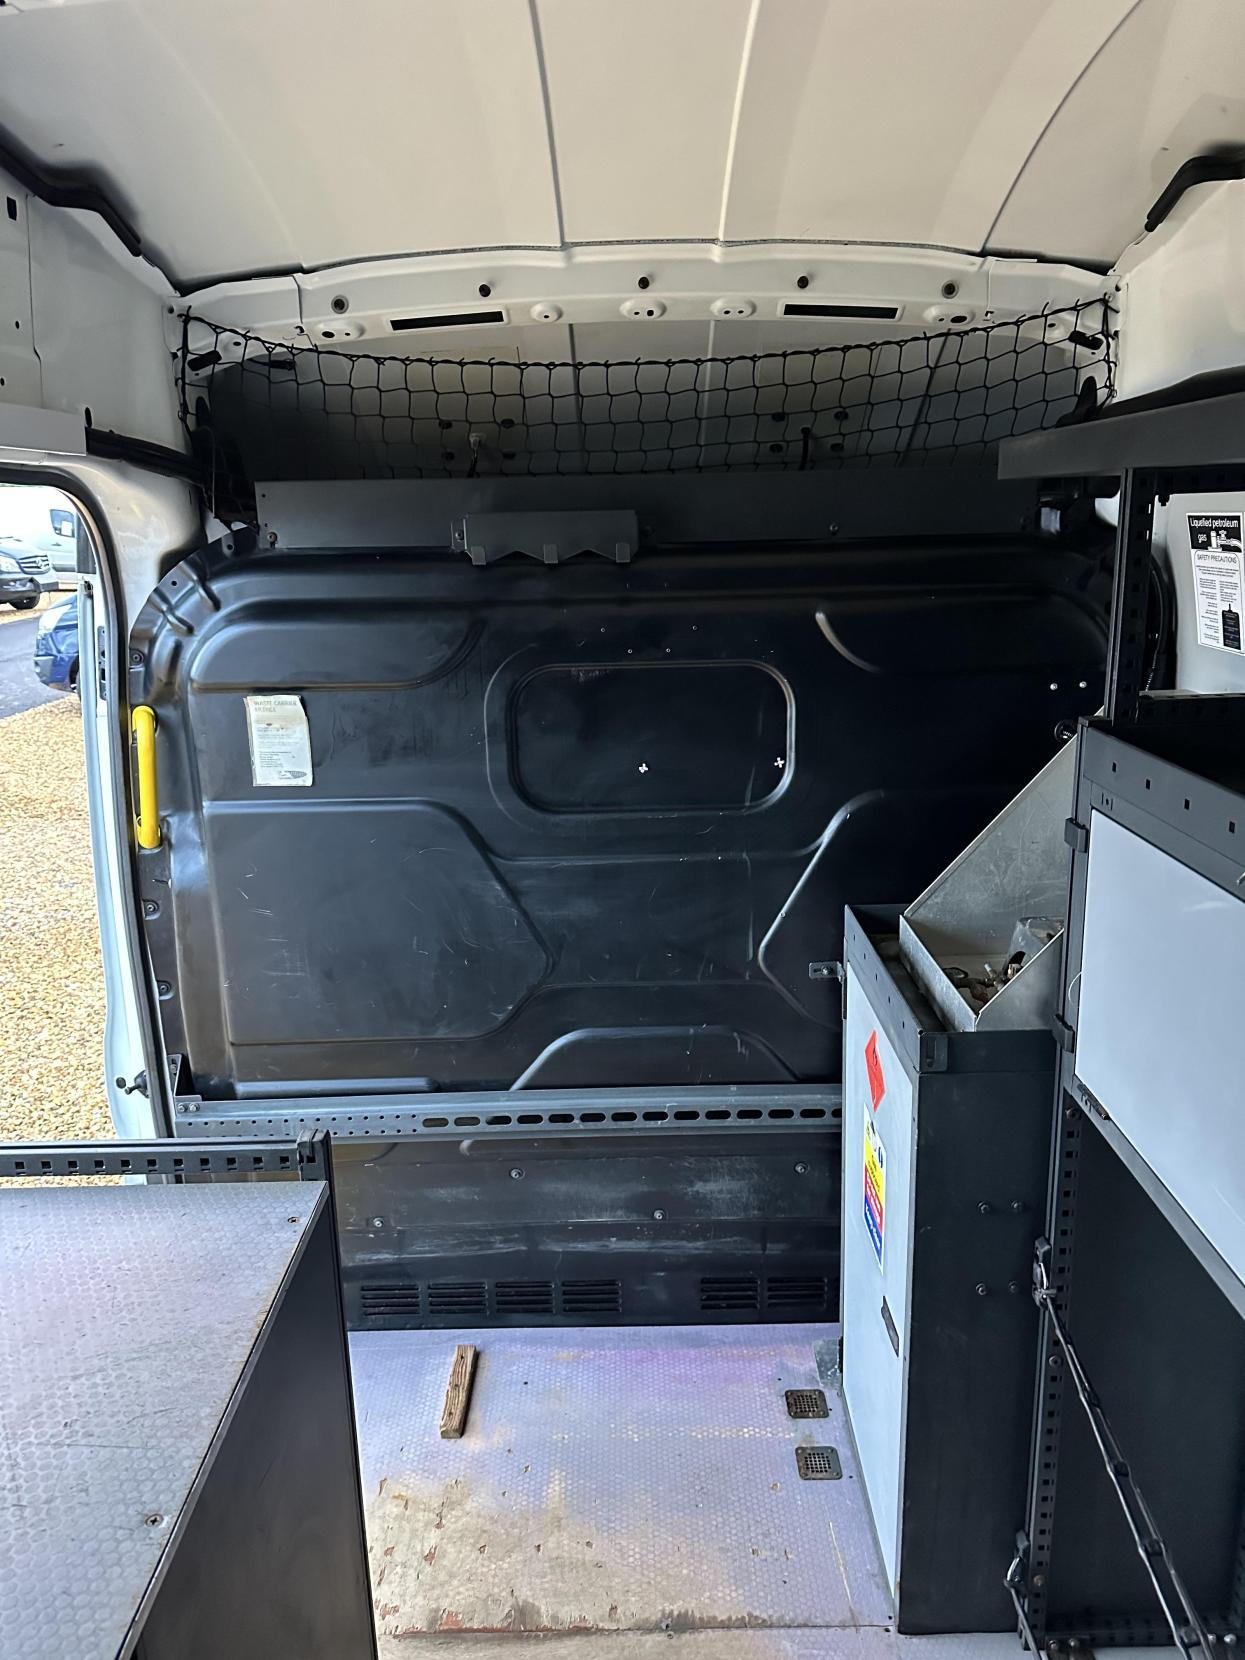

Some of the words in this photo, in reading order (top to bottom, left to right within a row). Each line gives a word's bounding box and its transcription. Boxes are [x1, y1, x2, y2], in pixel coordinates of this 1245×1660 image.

[1190, 517, 1212, 528] Liquefied
[1212, 517, 1238, 529] petroleum
[1197, 534, 1207, 543] gas
[1210, 554, 1237, 564] PRECAUTIONS
